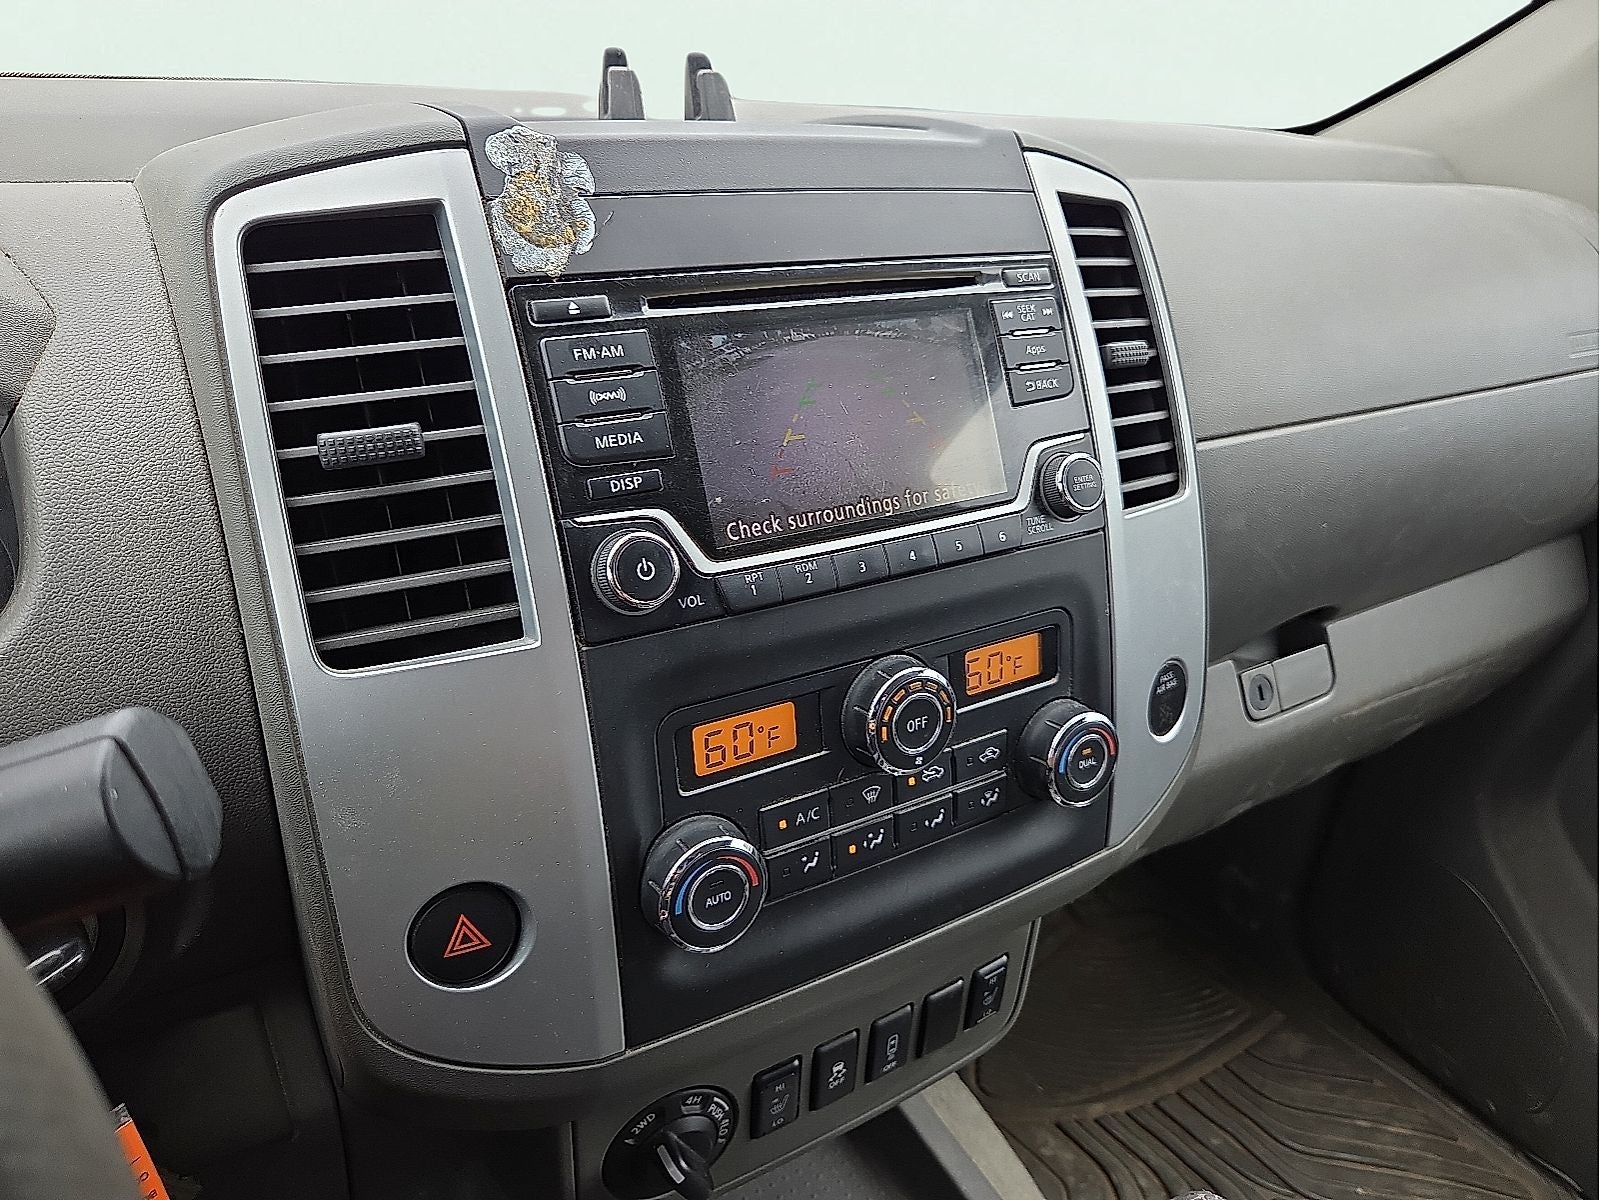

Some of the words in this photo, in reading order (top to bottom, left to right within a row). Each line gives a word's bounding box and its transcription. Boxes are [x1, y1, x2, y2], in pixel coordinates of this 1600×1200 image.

[1016, 272, 1041, 283] SCAN
[1016, 304, 1036, 314] SEEK
[1020, 312, 1036, 322] CAT
[1025, 345, 1046, 356] Apps
[1035, 378, 1059, 391] BACK
[594, 431, 644, 450] MEDIA
[609, 476, 643, 493] DISP
[1073, 474, 1094, 484] ENTER
[1072, 481, 1097, 492] SETTING
[726, 512, 783, 542] Check
[787, 494, 901, 532] surroundings
[903, 487, 929, 508] for
[1025, 514, 1047, 526] TUNE
[1027, 522, 1055, 535] SCROLL
[999, 530, 1007, 542] 6
[954, 540, 963, 551] 5
[908, 549, 917, 562] 4
[795, 561, 818, 574] RDM
[858, 561, 867, 573] 3
[744, 571, 764, 584] RPT
[804, 573, 813, 584] 2
[750, 584, 758, 596] 1
[677, 594, 706, 609] VOL
[906, 715, 929, 733] OFF
[1078, 756, 1099, 769] DUAL
[795, 806, 821, 827] A/C
[705, 890, 732, 909] AUTO
[774, 1082, 787, 1093] HI
[828, 1076, 847, 1090] OFF
[684, 1095, 703, 1105] 4H
[706, 1102, 726, 1121] PUSH
[629, 1112, 656, 1136] 2WD
